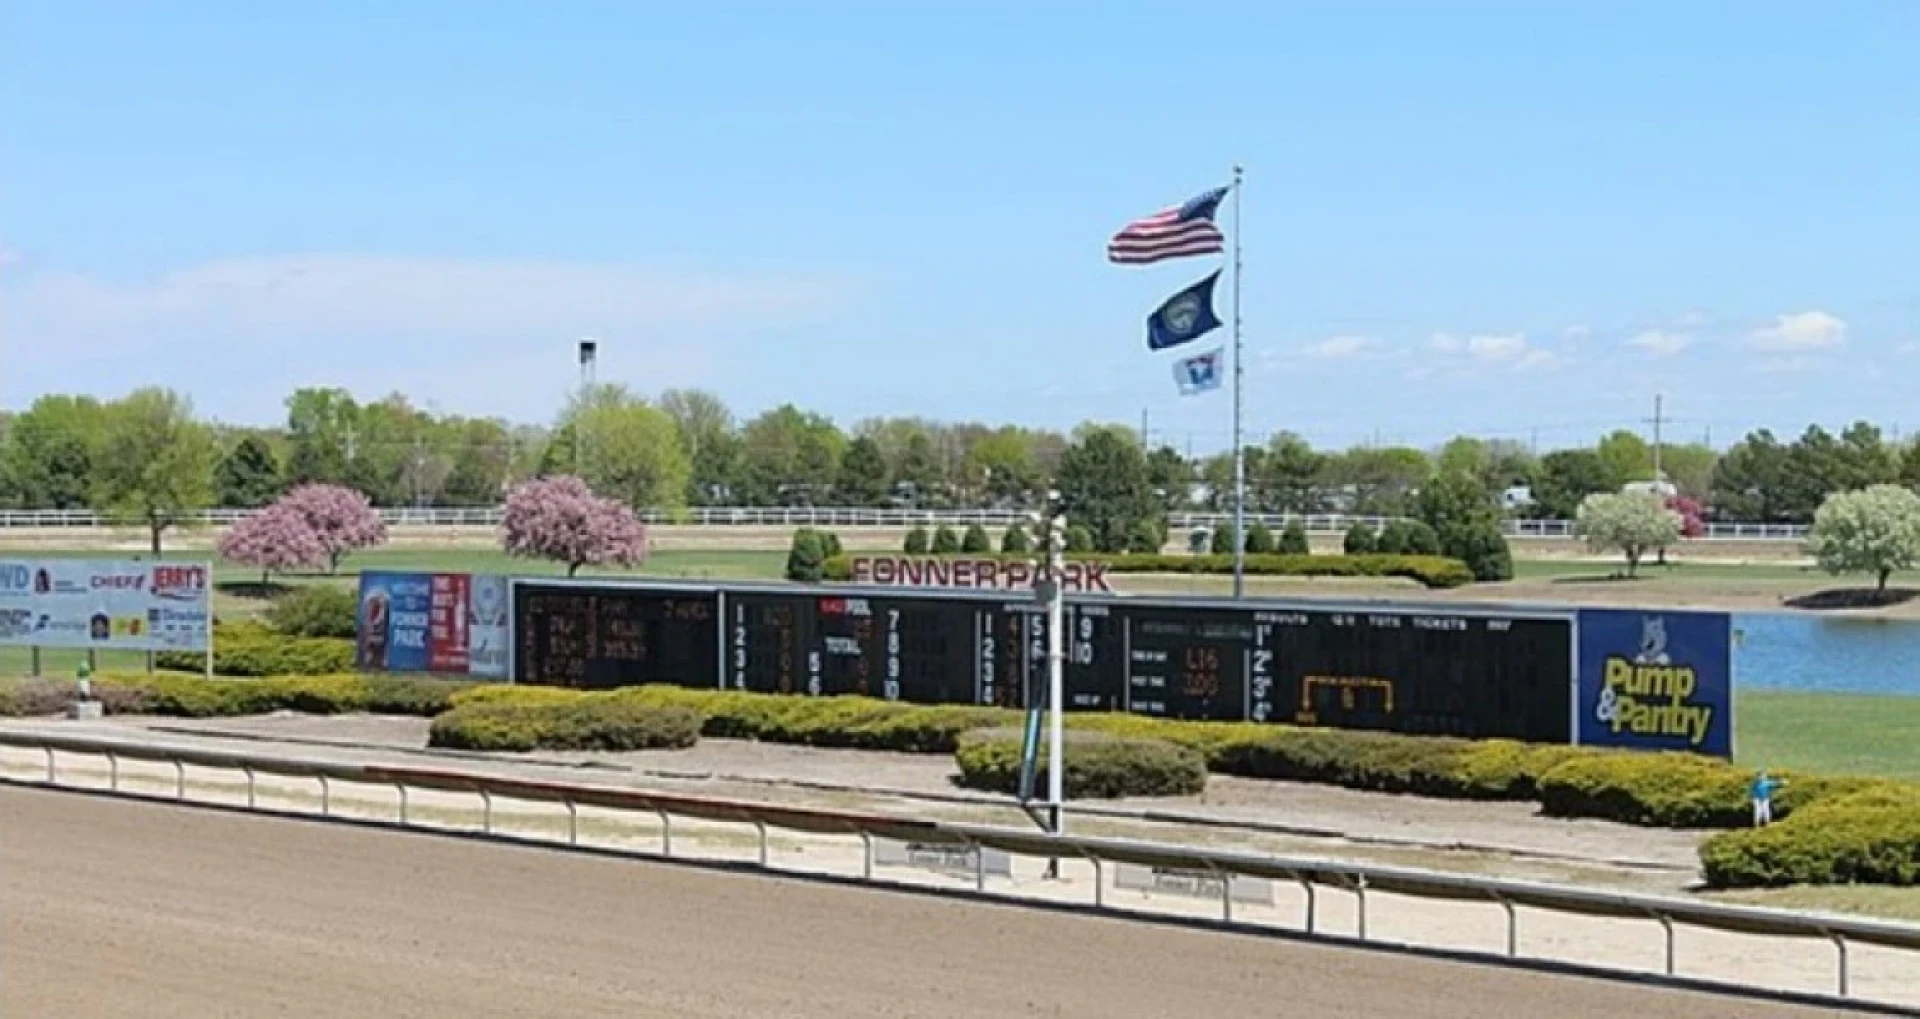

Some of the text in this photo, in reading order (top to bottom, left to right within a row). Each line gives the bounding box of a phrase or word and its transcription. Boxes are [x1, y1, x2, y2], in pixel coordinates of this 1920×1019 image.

[851, 558, 1109, 590] FONNER PARK
[889, 610, 899, 630] 7
[985, 613, 992, 633] 1
[1031, 615, 1043, 635] 5
[1081, 616, 1092, 638] 9
[735, 627, 745, 646] 2
[824, 637, 860, 654] TOTAL
[983, 637, 994, 659] 2
[1605, 658, 1695, 707] Pump
[1597, 687, 1711, 744] & Pantry
